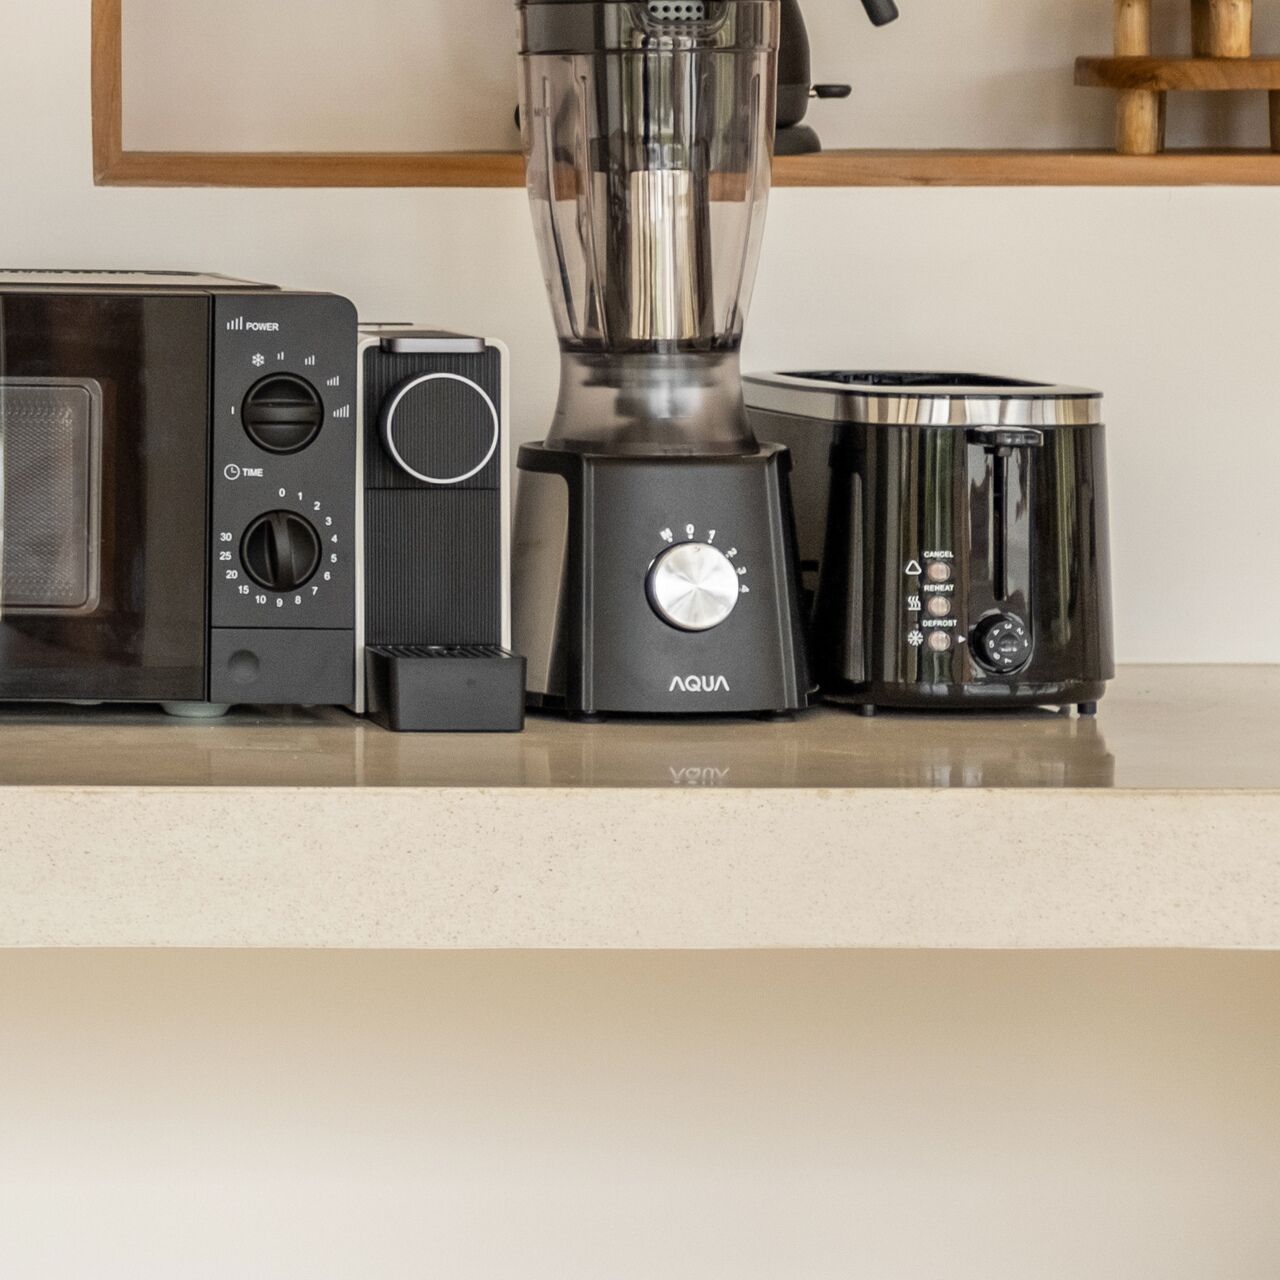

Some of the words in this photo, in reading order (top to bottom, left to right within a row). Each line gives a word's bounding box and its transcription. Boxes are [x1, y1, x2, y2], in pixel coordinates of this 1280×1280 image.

[246, 322, 280, 331] POWER
[242, 468, 264, 477] TIME
[279, 488, 286, 497] 0
[298, 492, 303, 500] 1
[314, 501, 320, 510] 2
[325, 516, 332, 526] 3
[220, 532, 232, 541] 30
[331, 534, 338, 543] 4
[220, 551, 232, 560] 25
[331, 554, 337, 562] 5
[924, 550, 954, 558] CANCEL
[226, 570, 238, 579] 20
[324, 572, 330, 580] 6
[238, 585, 249, 594] 15
[312, 586, 318, 595] 7
[924, 584, 954, 592] REHEAT
[255, 595, 266, 604] 10
[276, 598, 283, 607] 9
[295, 596, 301, 604] 8
[669, 675, 730, 692] AQUA
